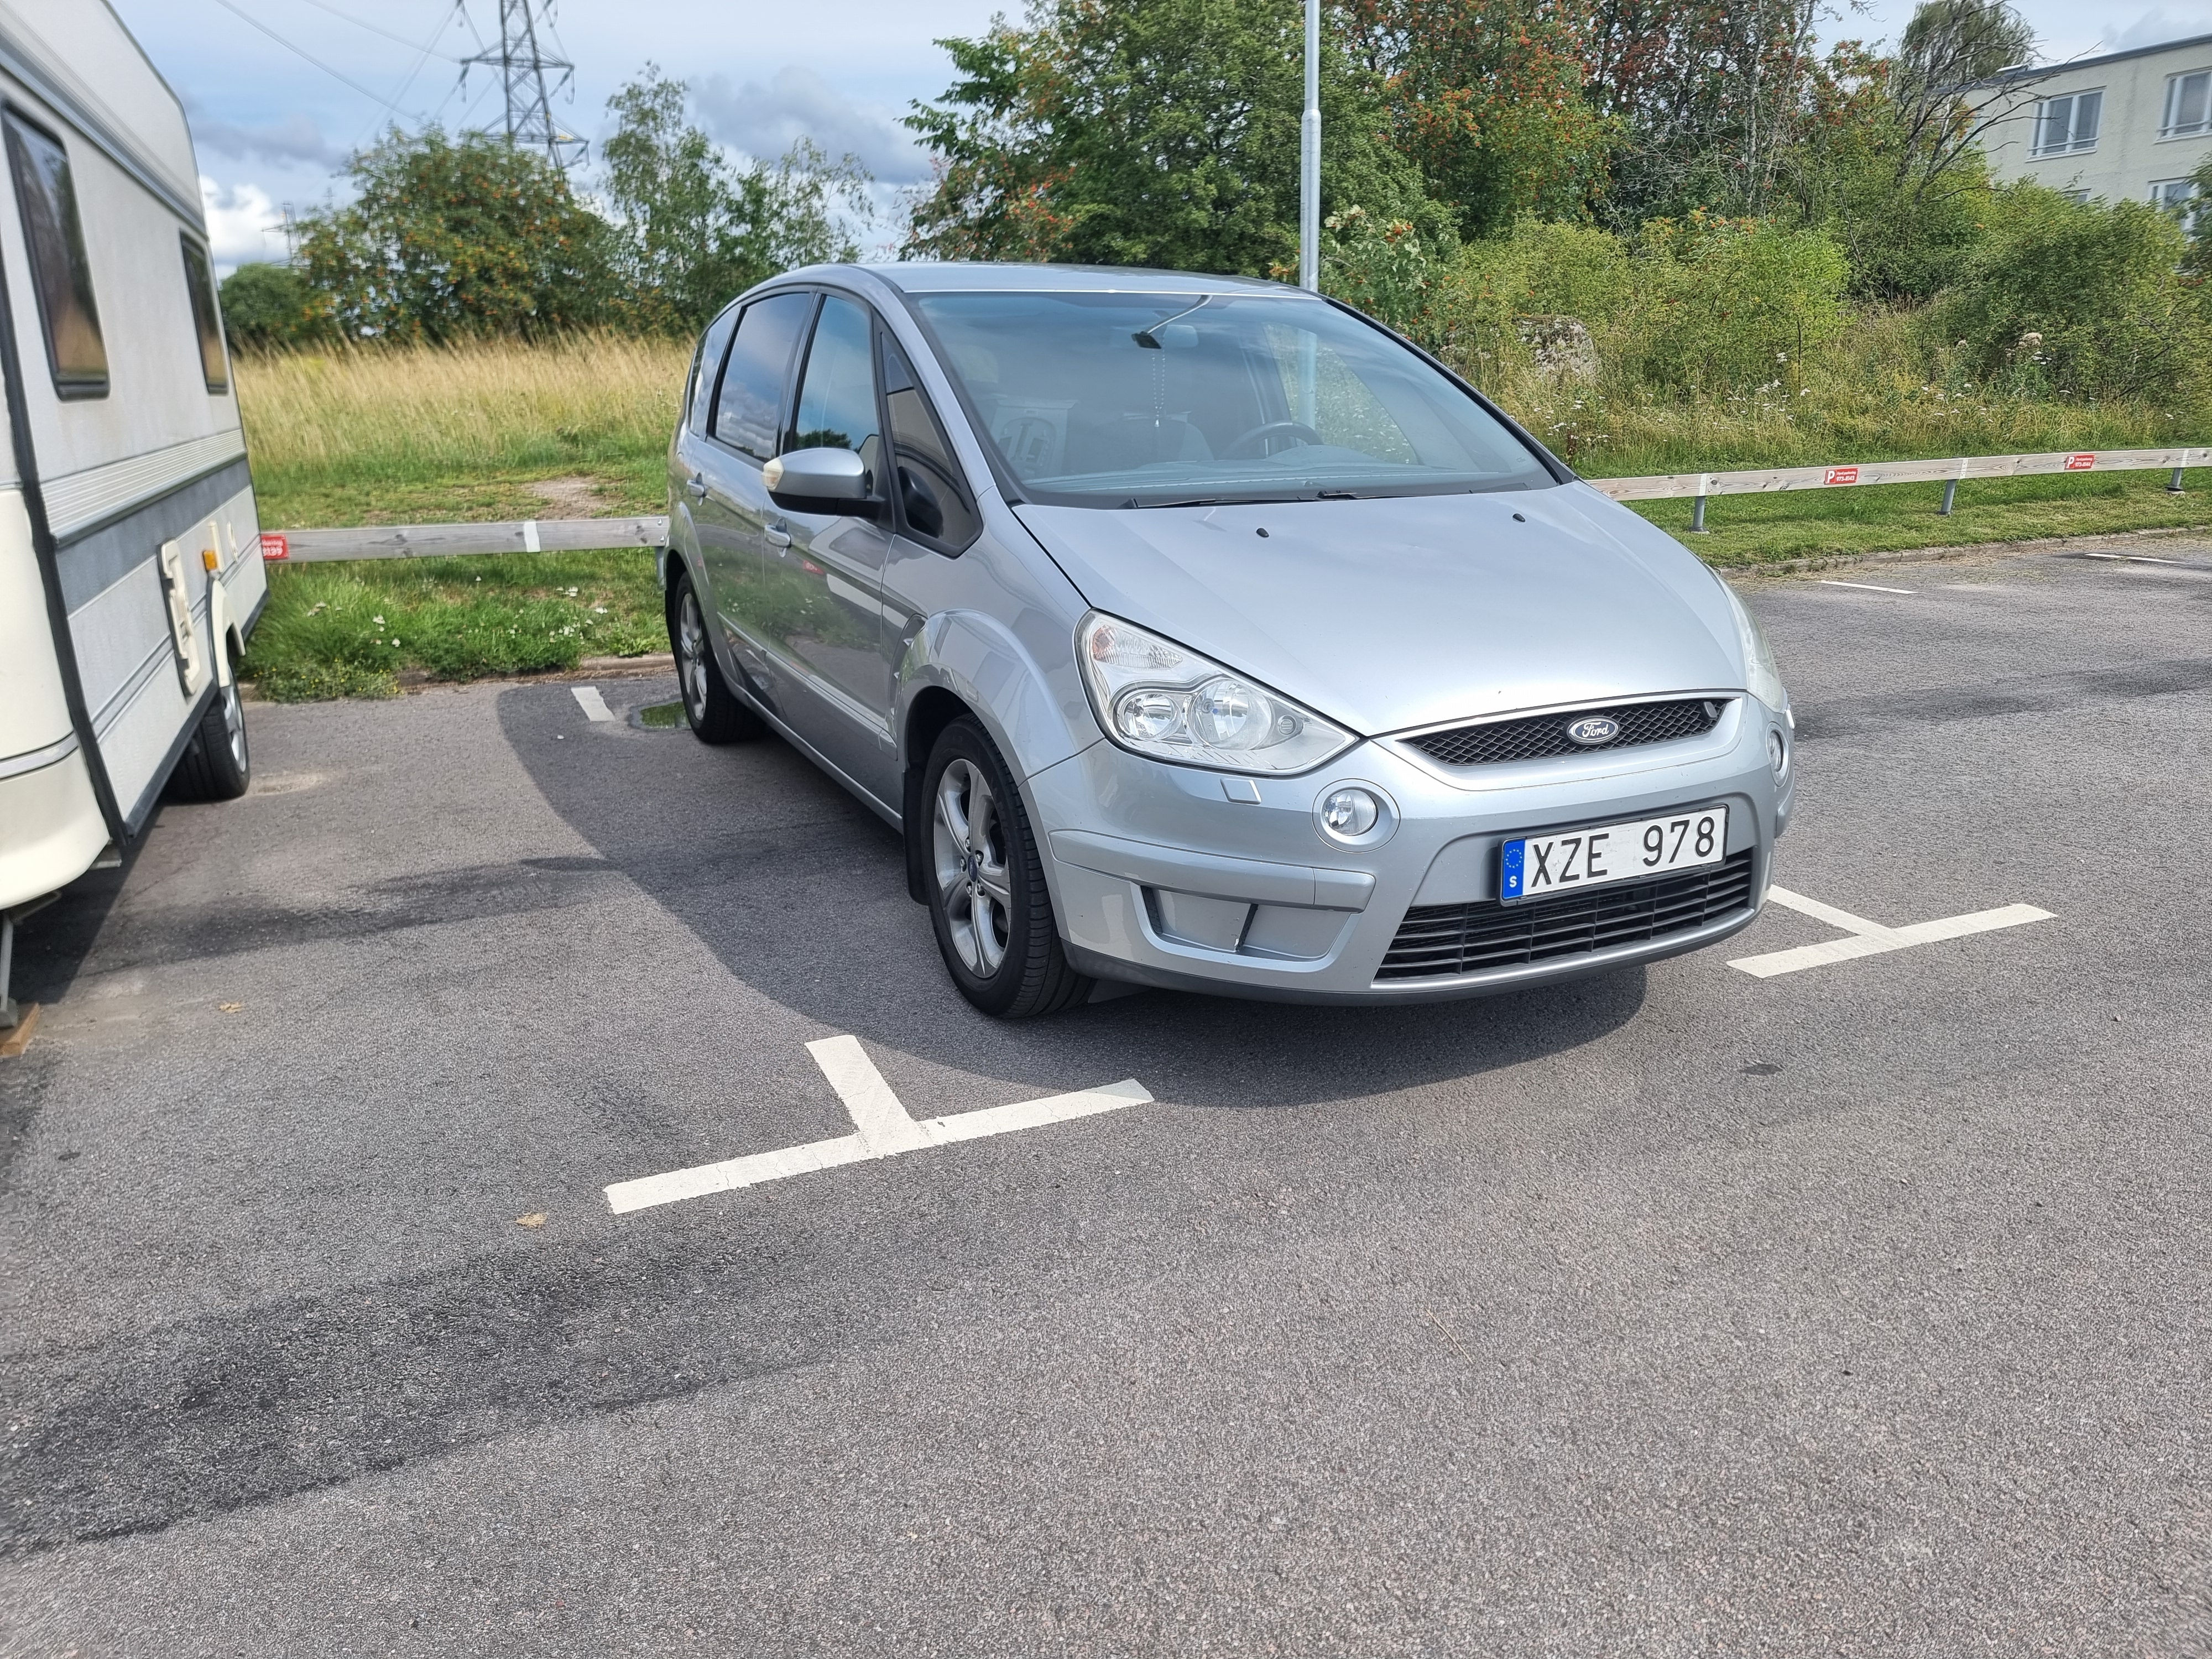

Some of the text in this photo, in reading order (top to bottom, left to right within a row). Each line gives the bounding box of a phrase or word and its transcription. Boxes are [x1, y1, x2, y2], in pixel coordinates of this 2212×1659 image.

[1827, 471, 1835, 483] P
[1582, 722, 1609, 738] Ford
[1531, 816, 1715, 888] XZE 978
[1510, 875, 1517, 888] S
